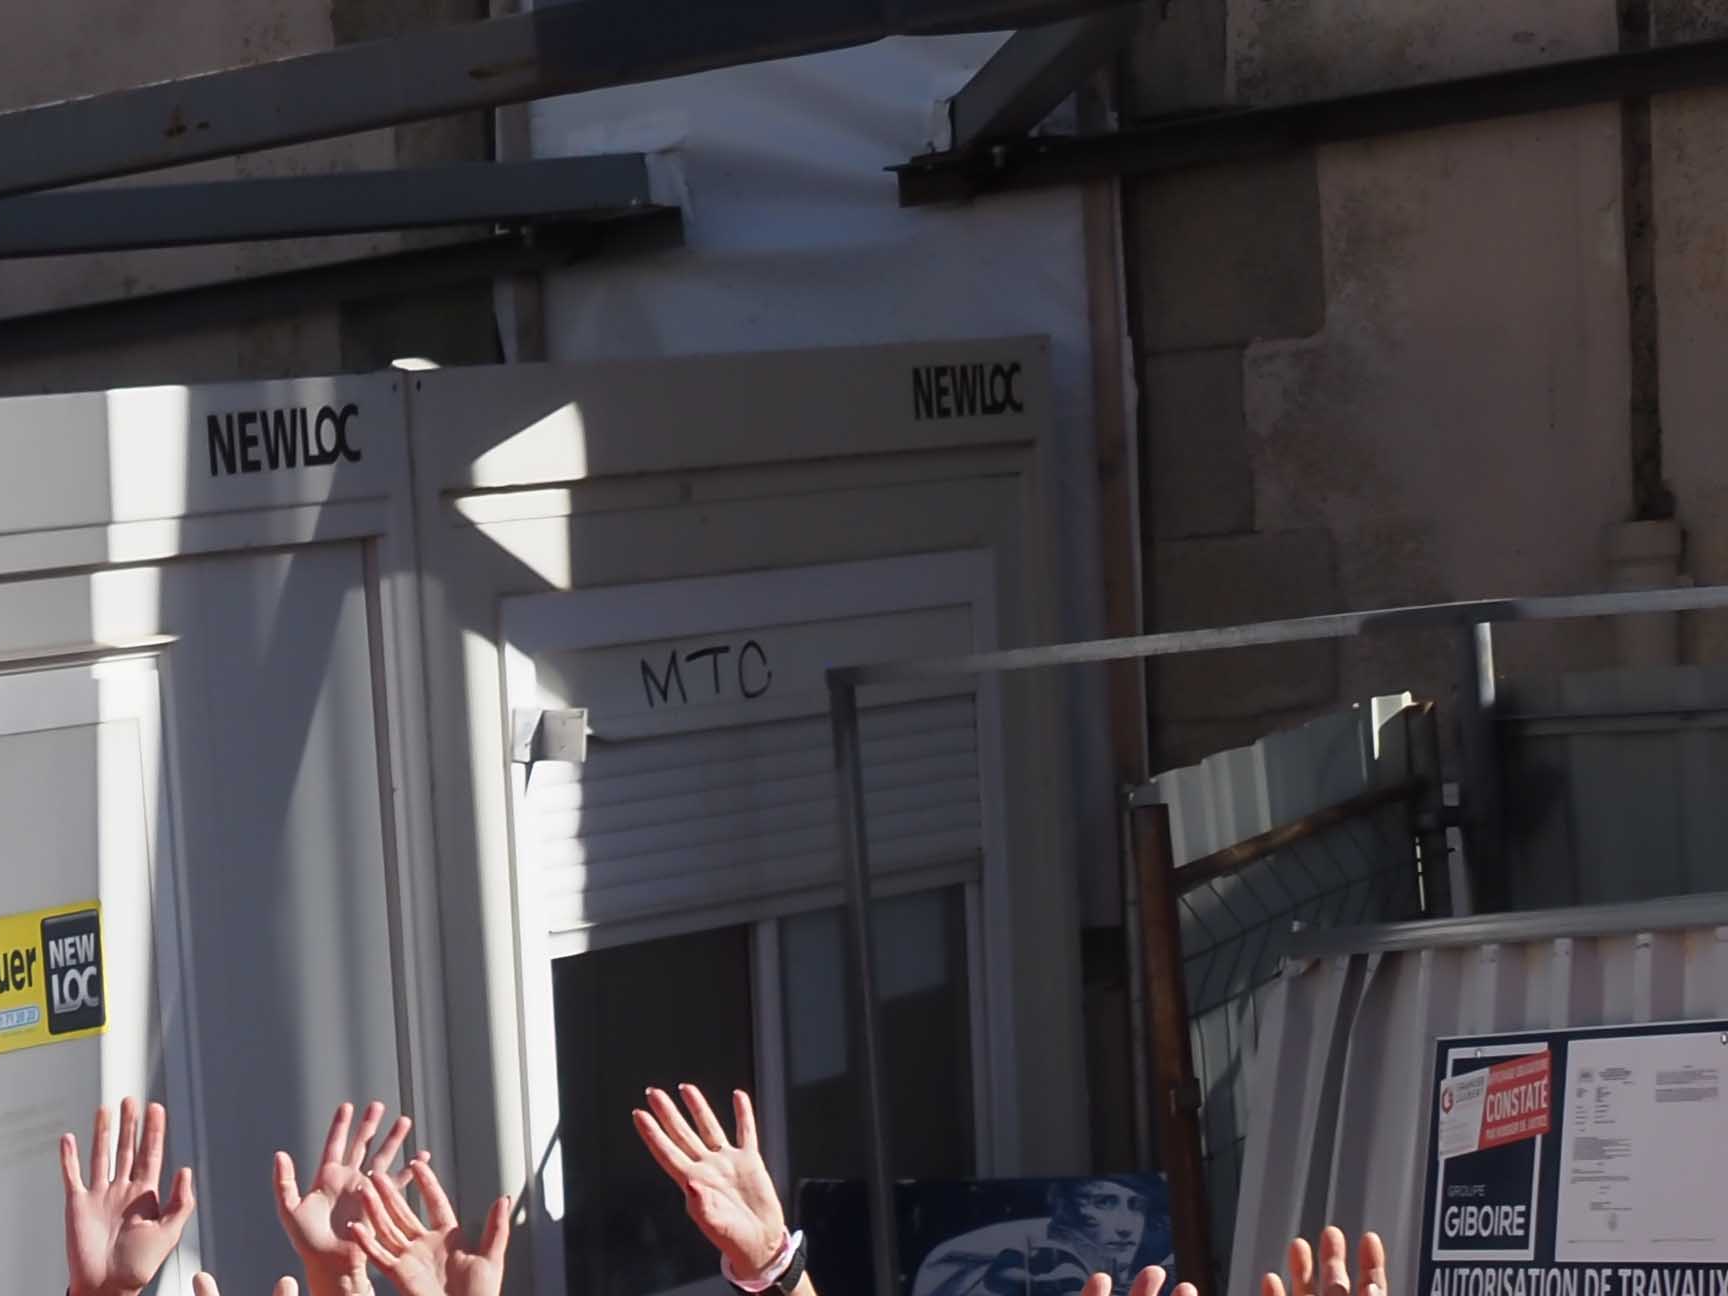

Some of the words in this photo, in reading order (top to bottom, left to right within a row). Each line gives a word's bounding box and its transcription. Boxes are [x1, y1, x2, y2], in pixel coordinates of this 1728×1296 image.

[912, 361, 1022, 421] NEWLOC
[208, 404, 361, 475] NEWLOC
[49, 933, 95, 969] NEW
[51, 966, 100, 1014] LOC
[1445, 1205, 1527, 1238] GIBOIRE
